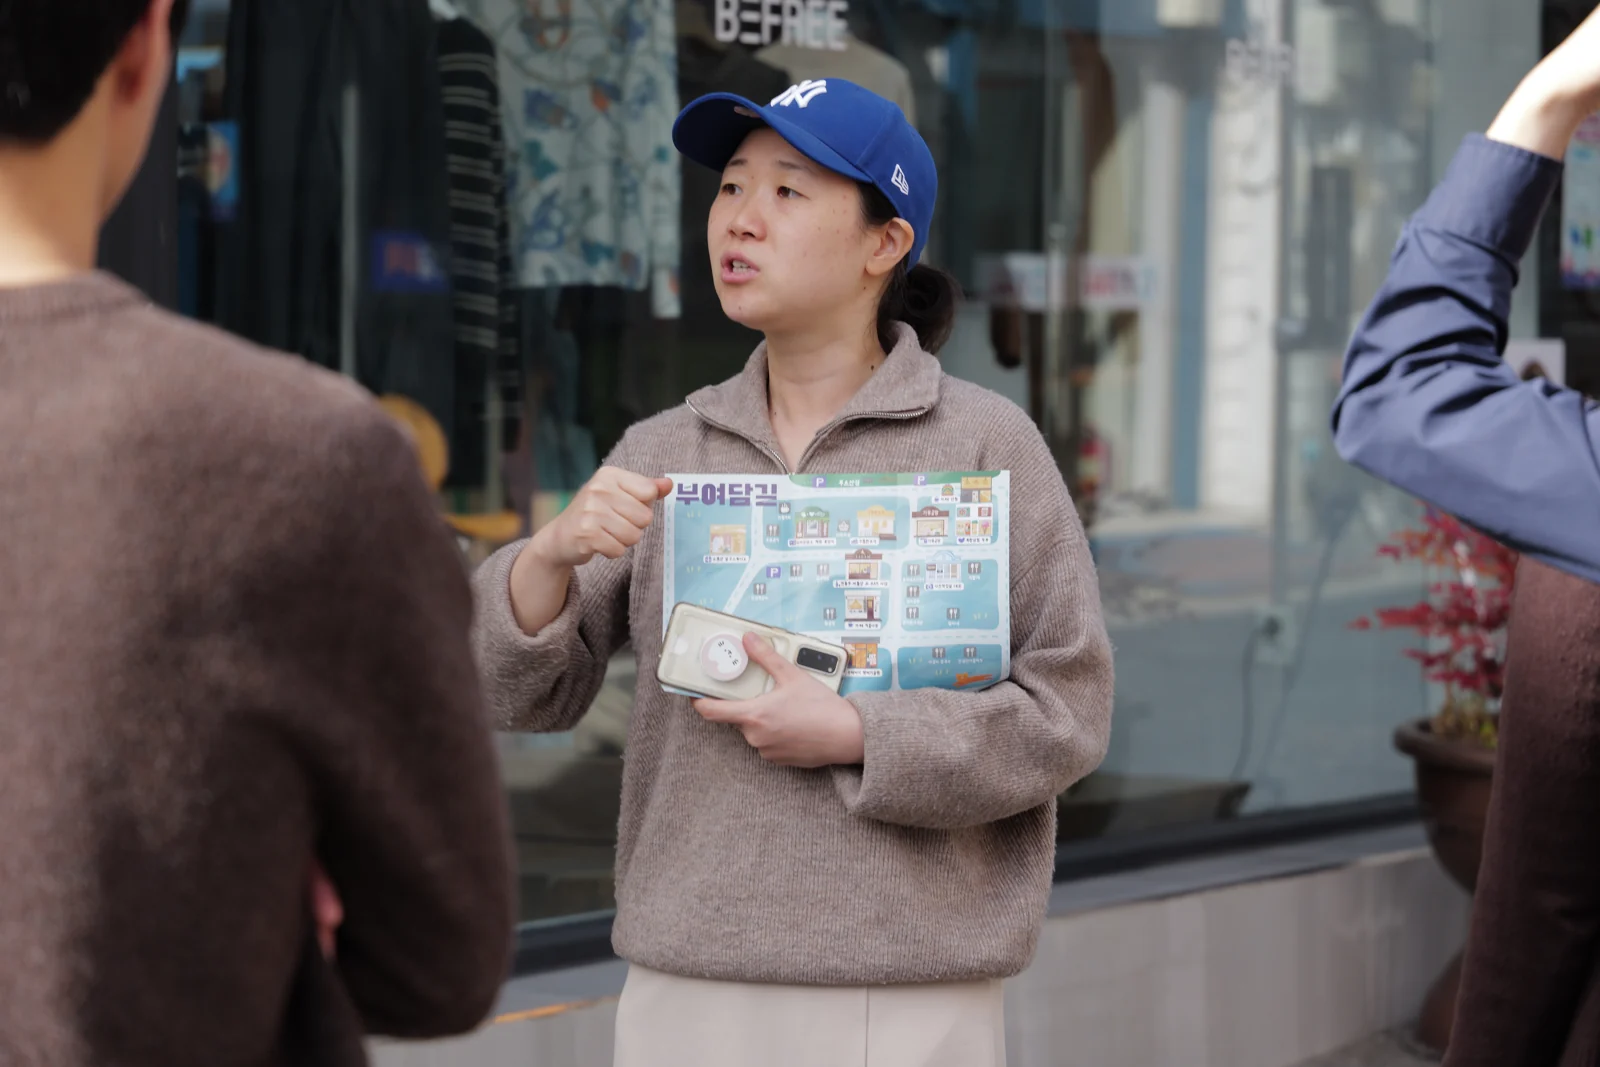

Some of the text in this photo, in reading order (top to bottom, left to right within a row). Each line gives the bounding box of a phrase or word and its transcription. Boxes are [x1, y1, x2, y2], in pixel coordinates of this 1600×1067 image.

[714, 0, 849, 51] BEFREE
[816, 477, 825, 488] P
[917, 475, 926, 485] P
[676, 483, 777, 507] 부여담길
[770, 567, 779, 578] P
